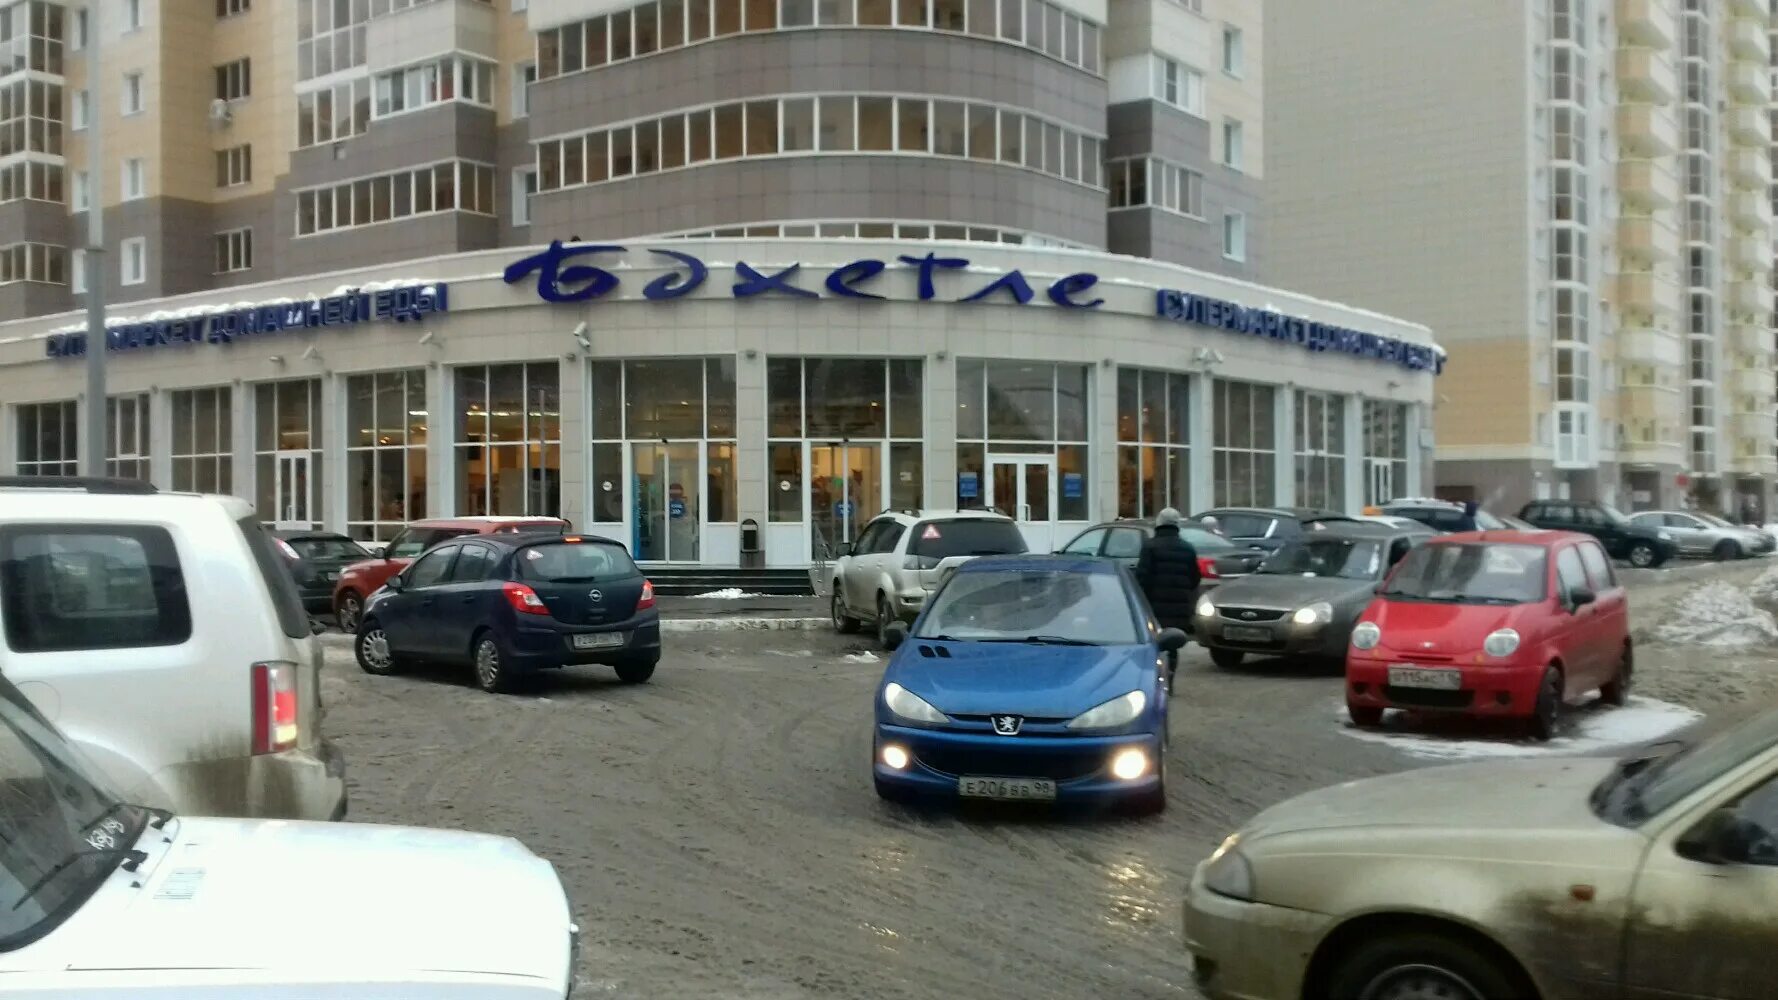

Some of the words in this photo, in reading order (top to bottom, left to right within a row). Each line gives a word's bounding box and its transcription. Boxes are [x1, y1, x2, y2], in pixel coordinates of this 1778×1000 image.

[47, 314, 203, 358] СУПМАРКЕТ
[207, 289, 370, 343] ДОМАШНЕЙ
[374, 281, 448, 322] ЕДЫ
[1157, 289, 1309, 347] СУПЕРМАРКЕТ
